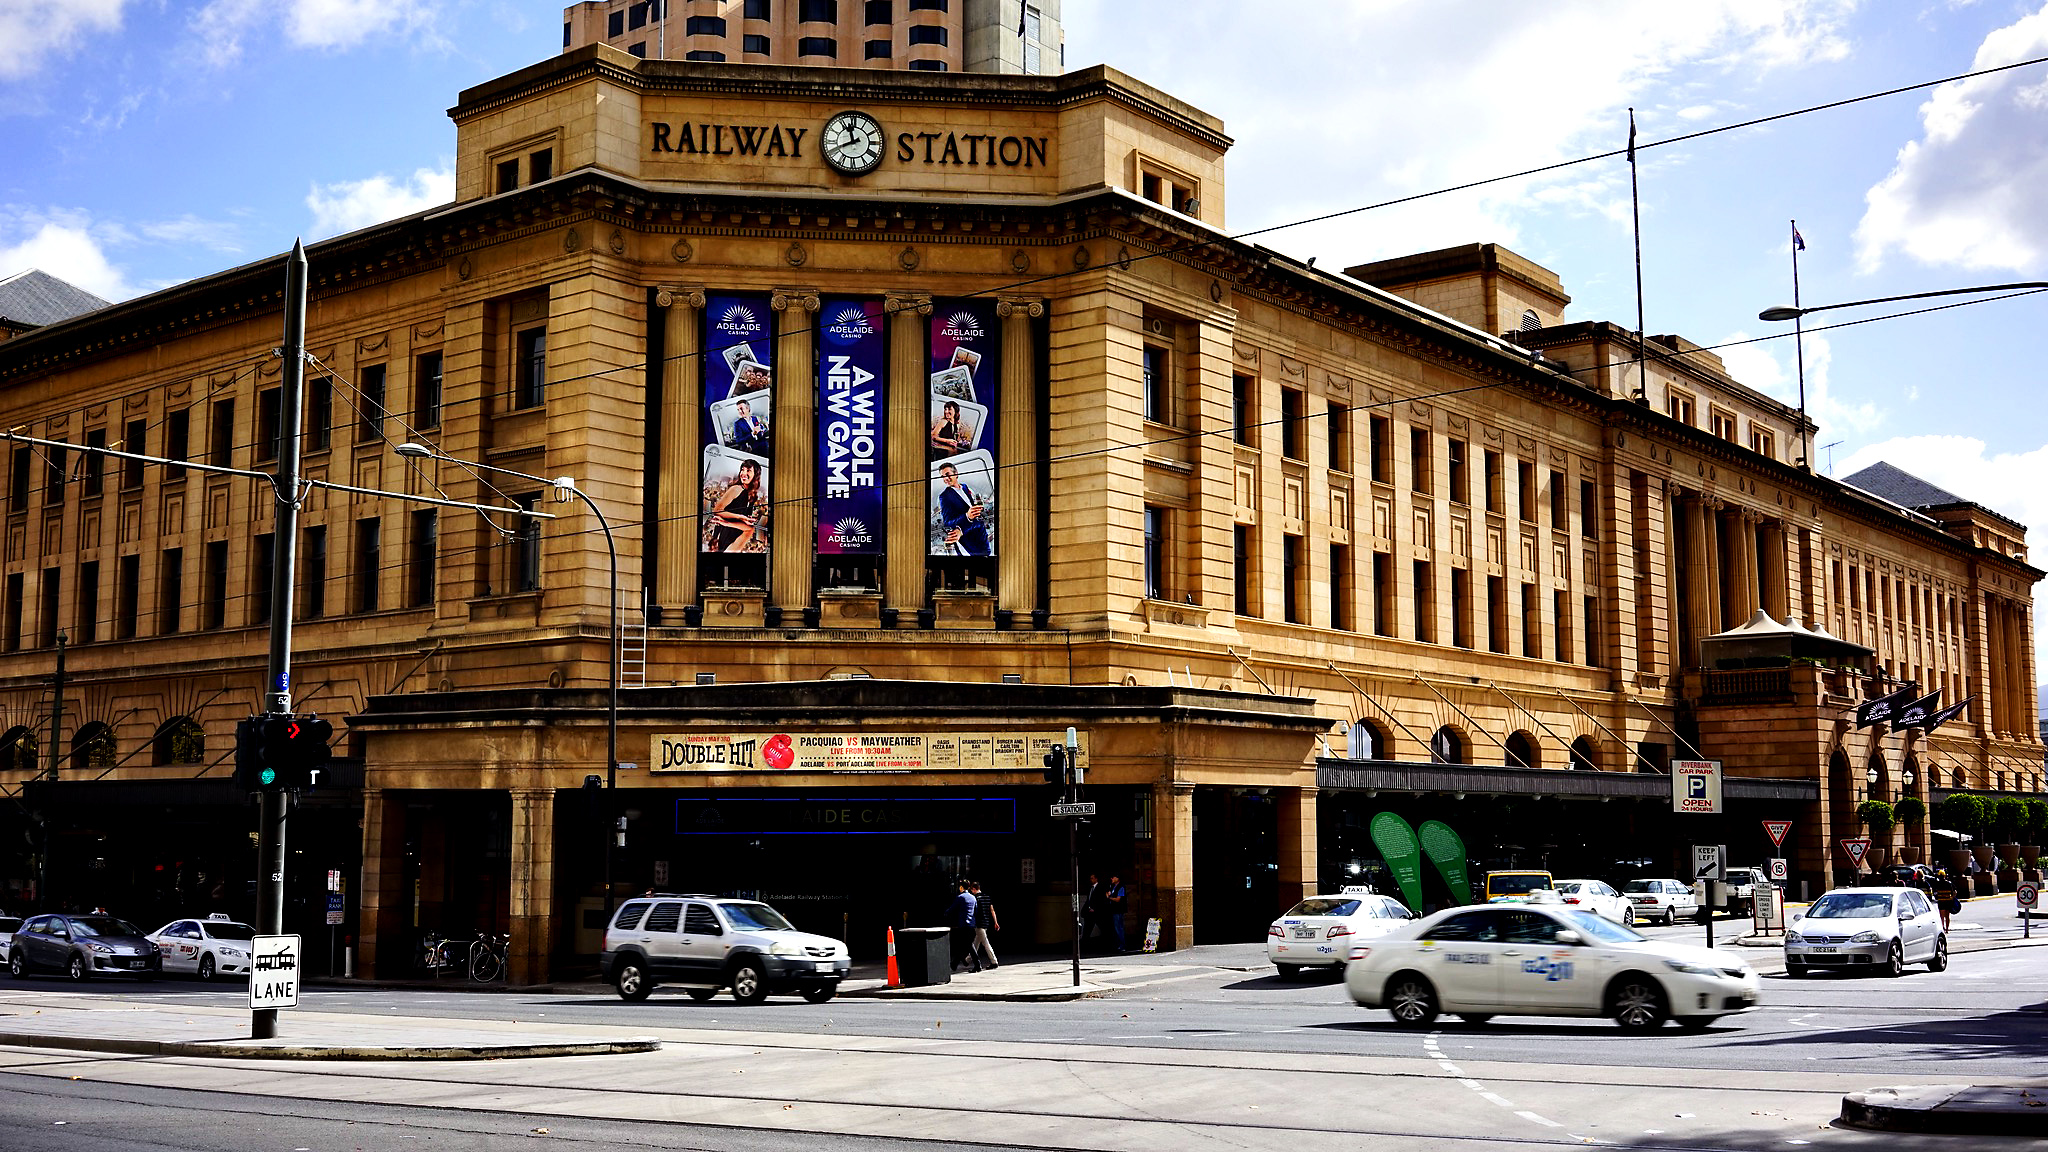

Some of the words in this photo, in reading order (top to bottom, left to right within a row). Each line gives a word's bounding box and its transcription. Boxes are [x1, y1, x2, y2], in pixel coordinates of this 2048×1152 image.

[651, 121, 808, 158] RAILWAY
[896, 131, 1049, 168] STATION
[716, 322, 761, 331] ADELAIDE
[829, 326, 874, 334] ADELAIDE
[940, 328, 985, 337] ADELAIDE
[852, 365, 875, 388] A
[827, 355, 851, 418] NEW
[851, 389, 875, 487] WHOLE
[827, 421, 850, 499] GAME
[827, 535, 873, 543] ADELAIDE
[277, 696, 289, 705] 52
[800, 737, 843, 747] PACQUIAO
[846, 737, 858, 746] VS
[861, 736, 922, 746] MAYWEATHER
[661, 739, 726, 769] DOUBLE
[729, 739, 756, 768] HIT
[830, 747, 844, 755] LIVE
[864, 747, 892, 755] 10:30AM
[1680, 761, 1713, 769] RIVERBANK
[1690, 778, 1705, 796] P
[1682, 799, 1713, 807] OPEN
[1060, 805, 1084, 814] STATION
[1084, 805, 1093, 813] RD
[1775, 864, 1784, 874] 15
[271, 872, 283, 882] 52
[2020, 889, 2034, 900] 30
[254, 981, 294, 999] LANE
